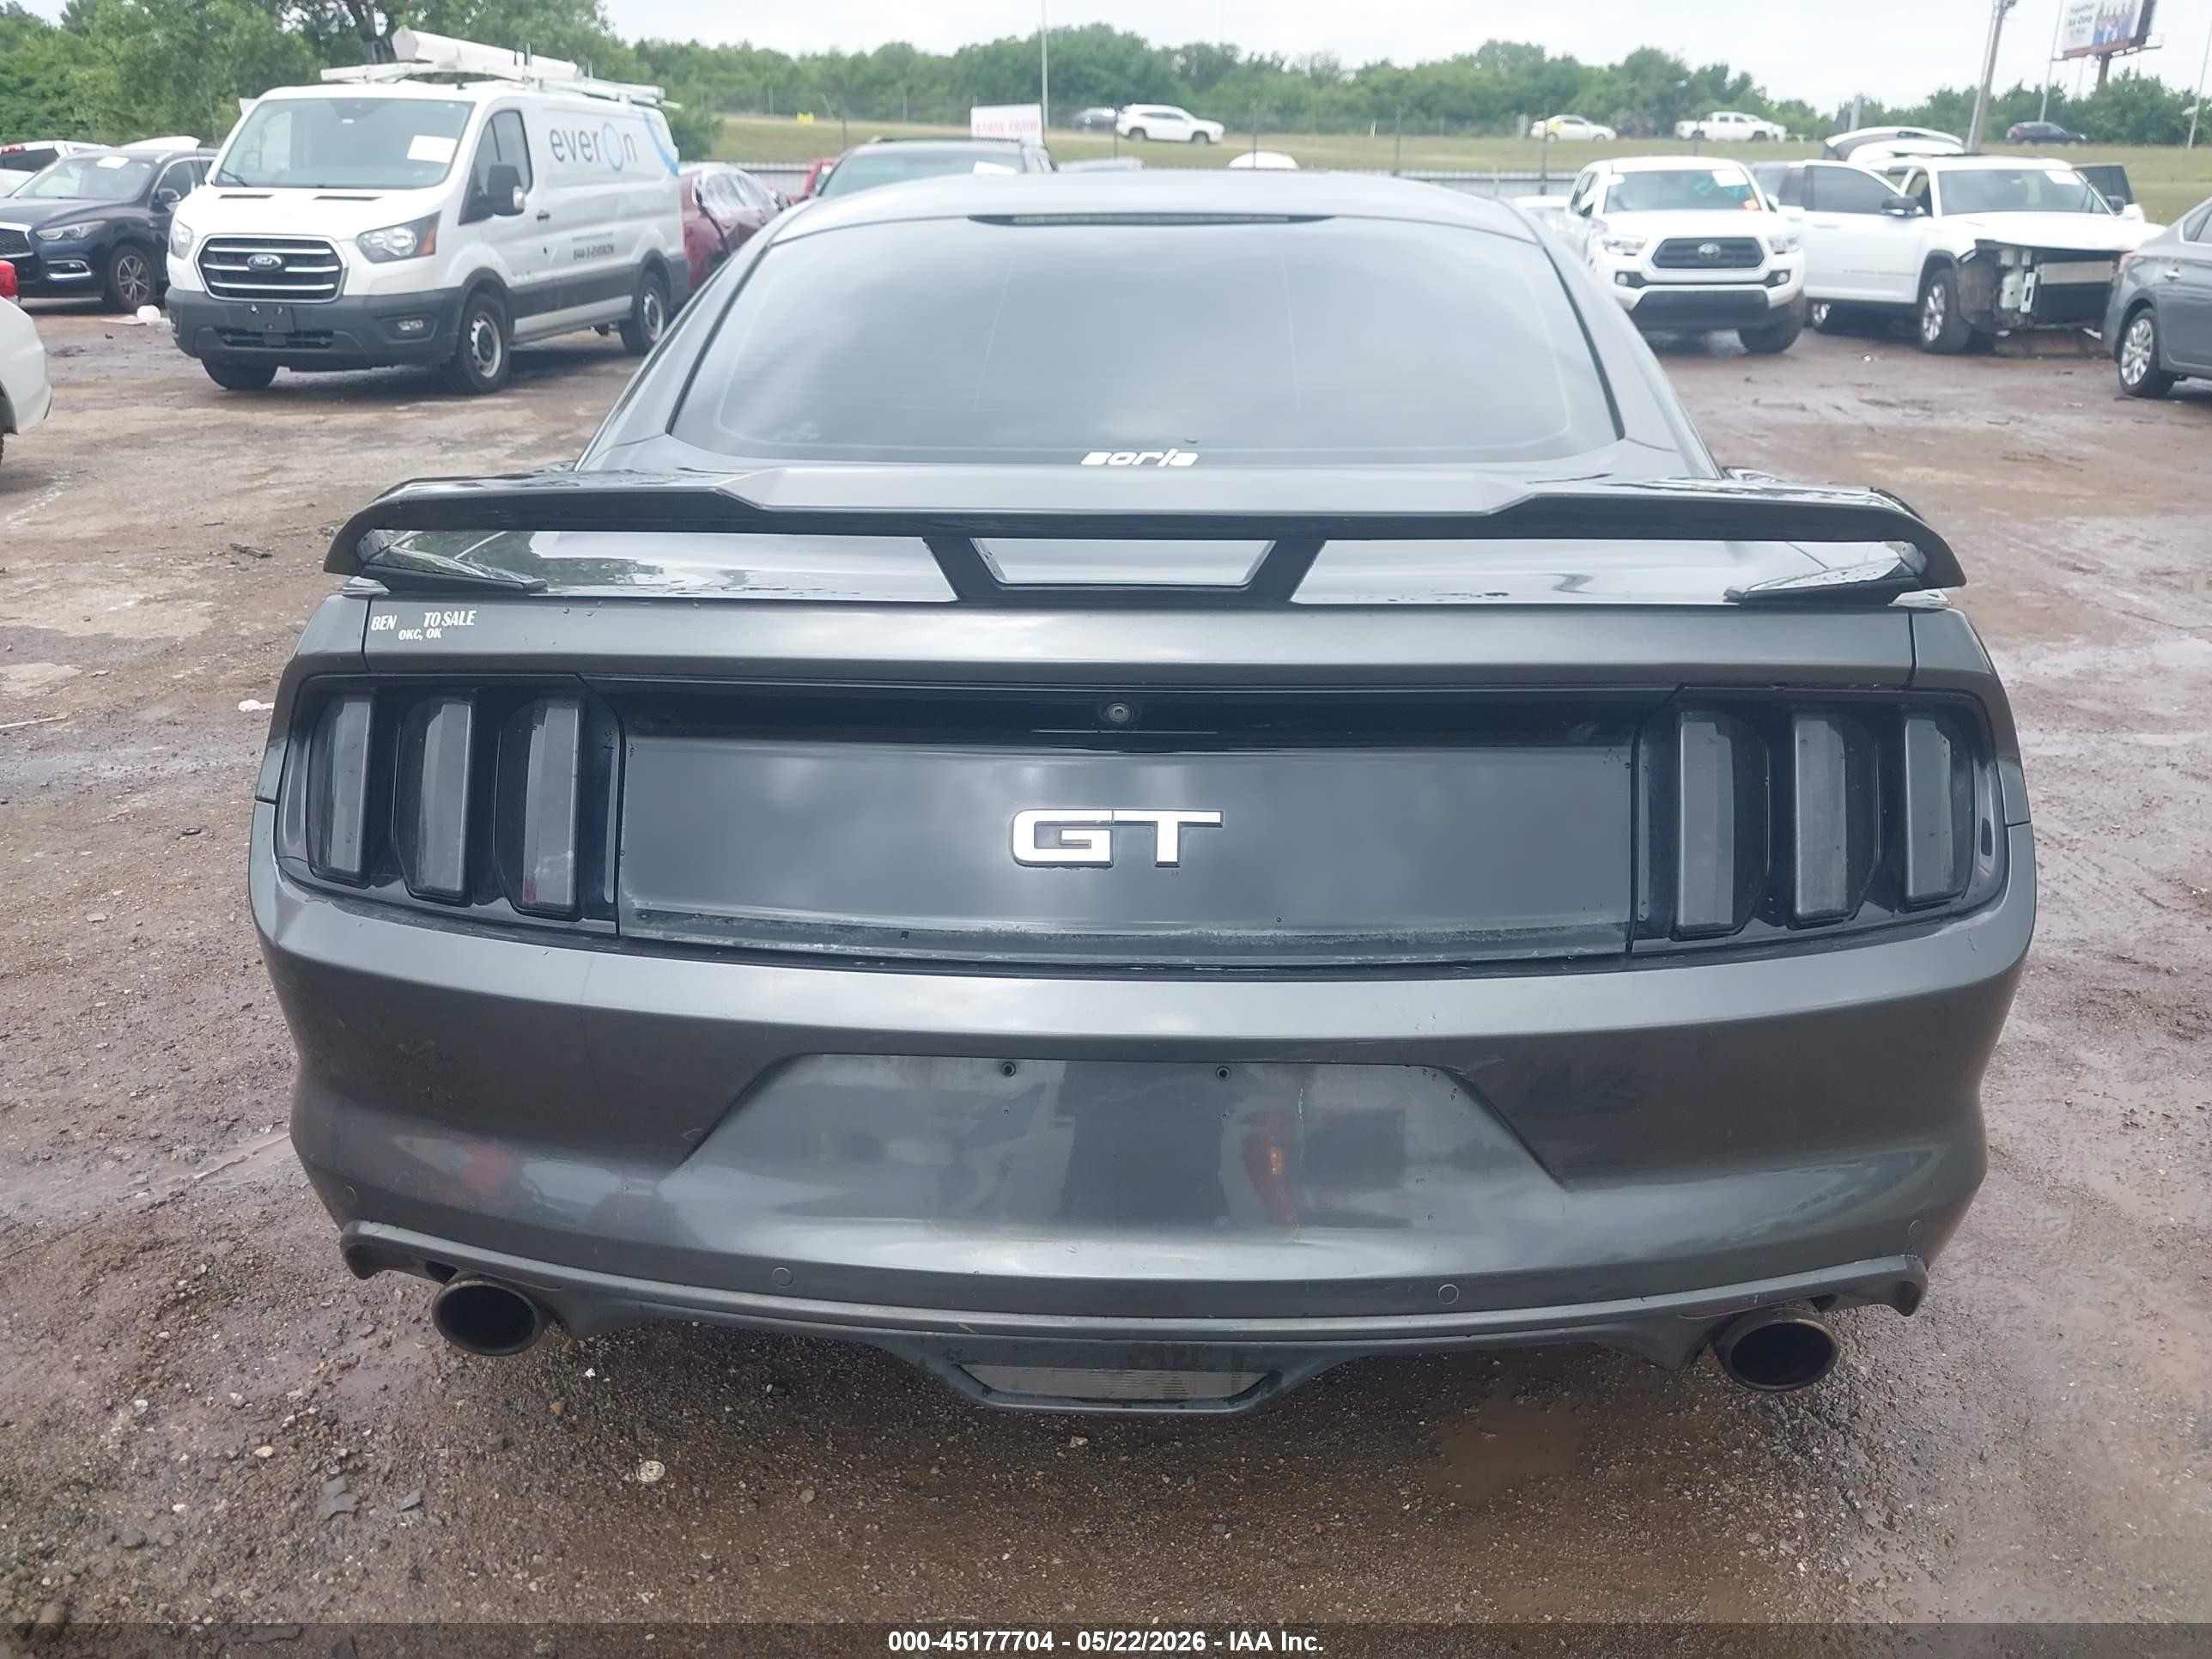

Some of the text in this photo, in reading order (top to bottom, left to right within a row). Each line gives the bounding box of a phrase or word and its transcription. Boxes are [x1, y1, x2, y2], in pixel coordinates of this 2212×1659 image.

[371, 610, 477, 631] BEN TO SALE
[426, 628, 442, 639] OK
[1012, 809, 1223, 867] GT
